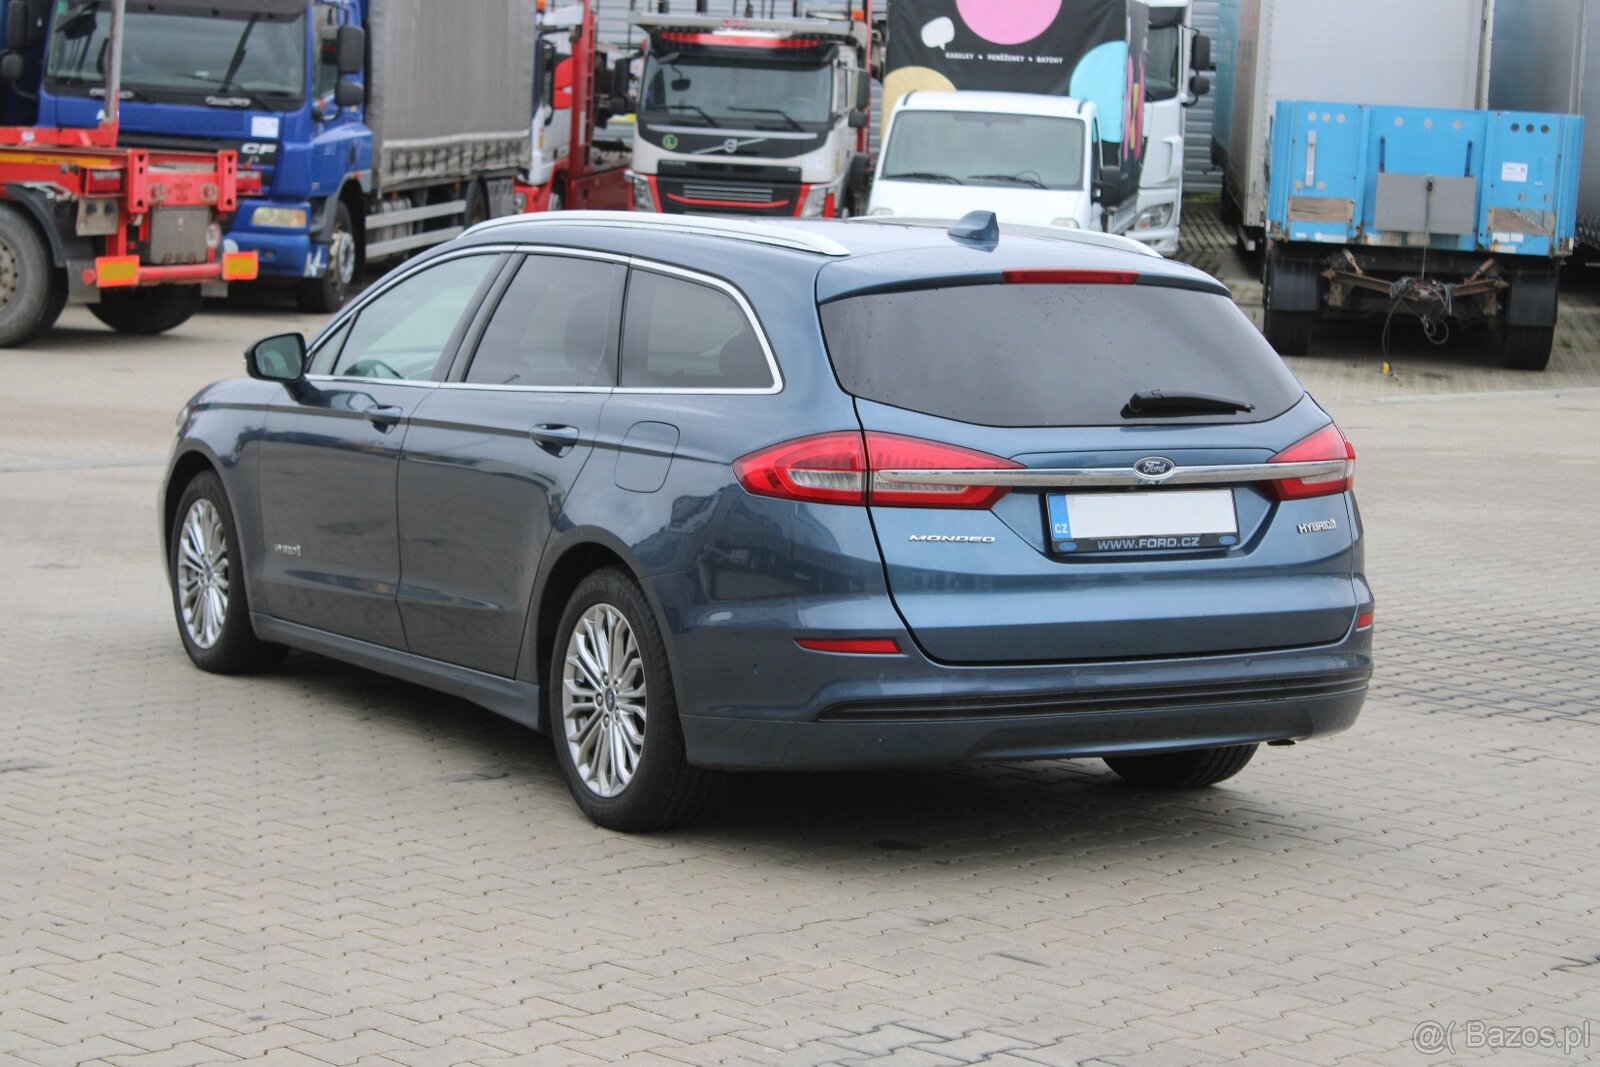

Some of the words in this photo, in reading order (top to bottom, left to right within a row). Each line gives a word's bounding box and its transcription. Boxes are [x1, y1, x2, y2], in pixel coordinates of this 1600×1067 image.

[241, 142, 277, 154] CF
[1143, 460, 1166, 473] Ford
[1054, 523, 1069, 534] CZ
[908, 534, 996, 543] MONDEO
[1097, 537, 1201, 551] WWW.FORD.CZ
